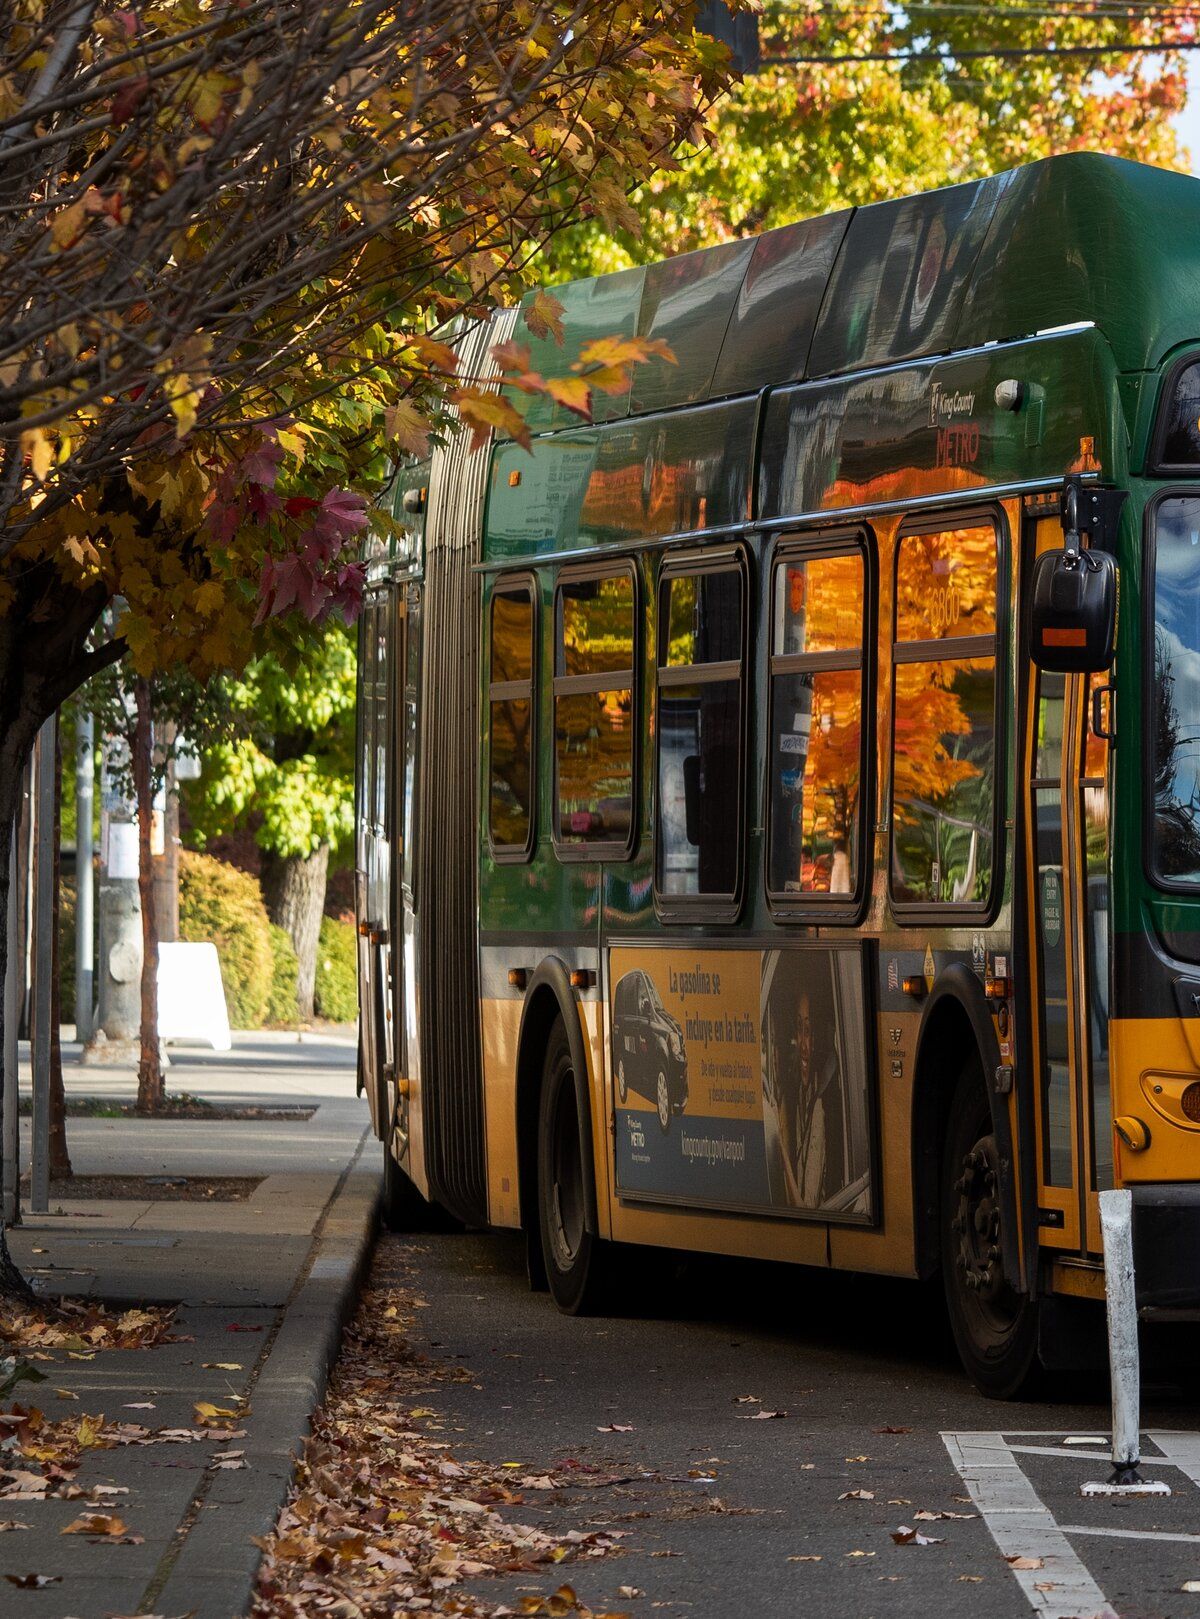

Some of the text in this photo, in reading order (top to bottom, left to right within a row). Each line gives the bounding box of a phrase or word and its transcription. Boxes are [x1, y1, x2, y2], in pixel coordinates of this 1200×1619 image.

[940, 390, 976, 420] King County
[936, 422, 979, 467] METRO
[930, 587, 960, 627] 6800
[669, 964, 720, 1001] La gasolina se
[685, 1011, 757, 1049] incluye en la tarifa.
[631, 1132, 645, 1147] METRO
[681, 1129, 745, 1167] kingcounty.gov/vanpool
